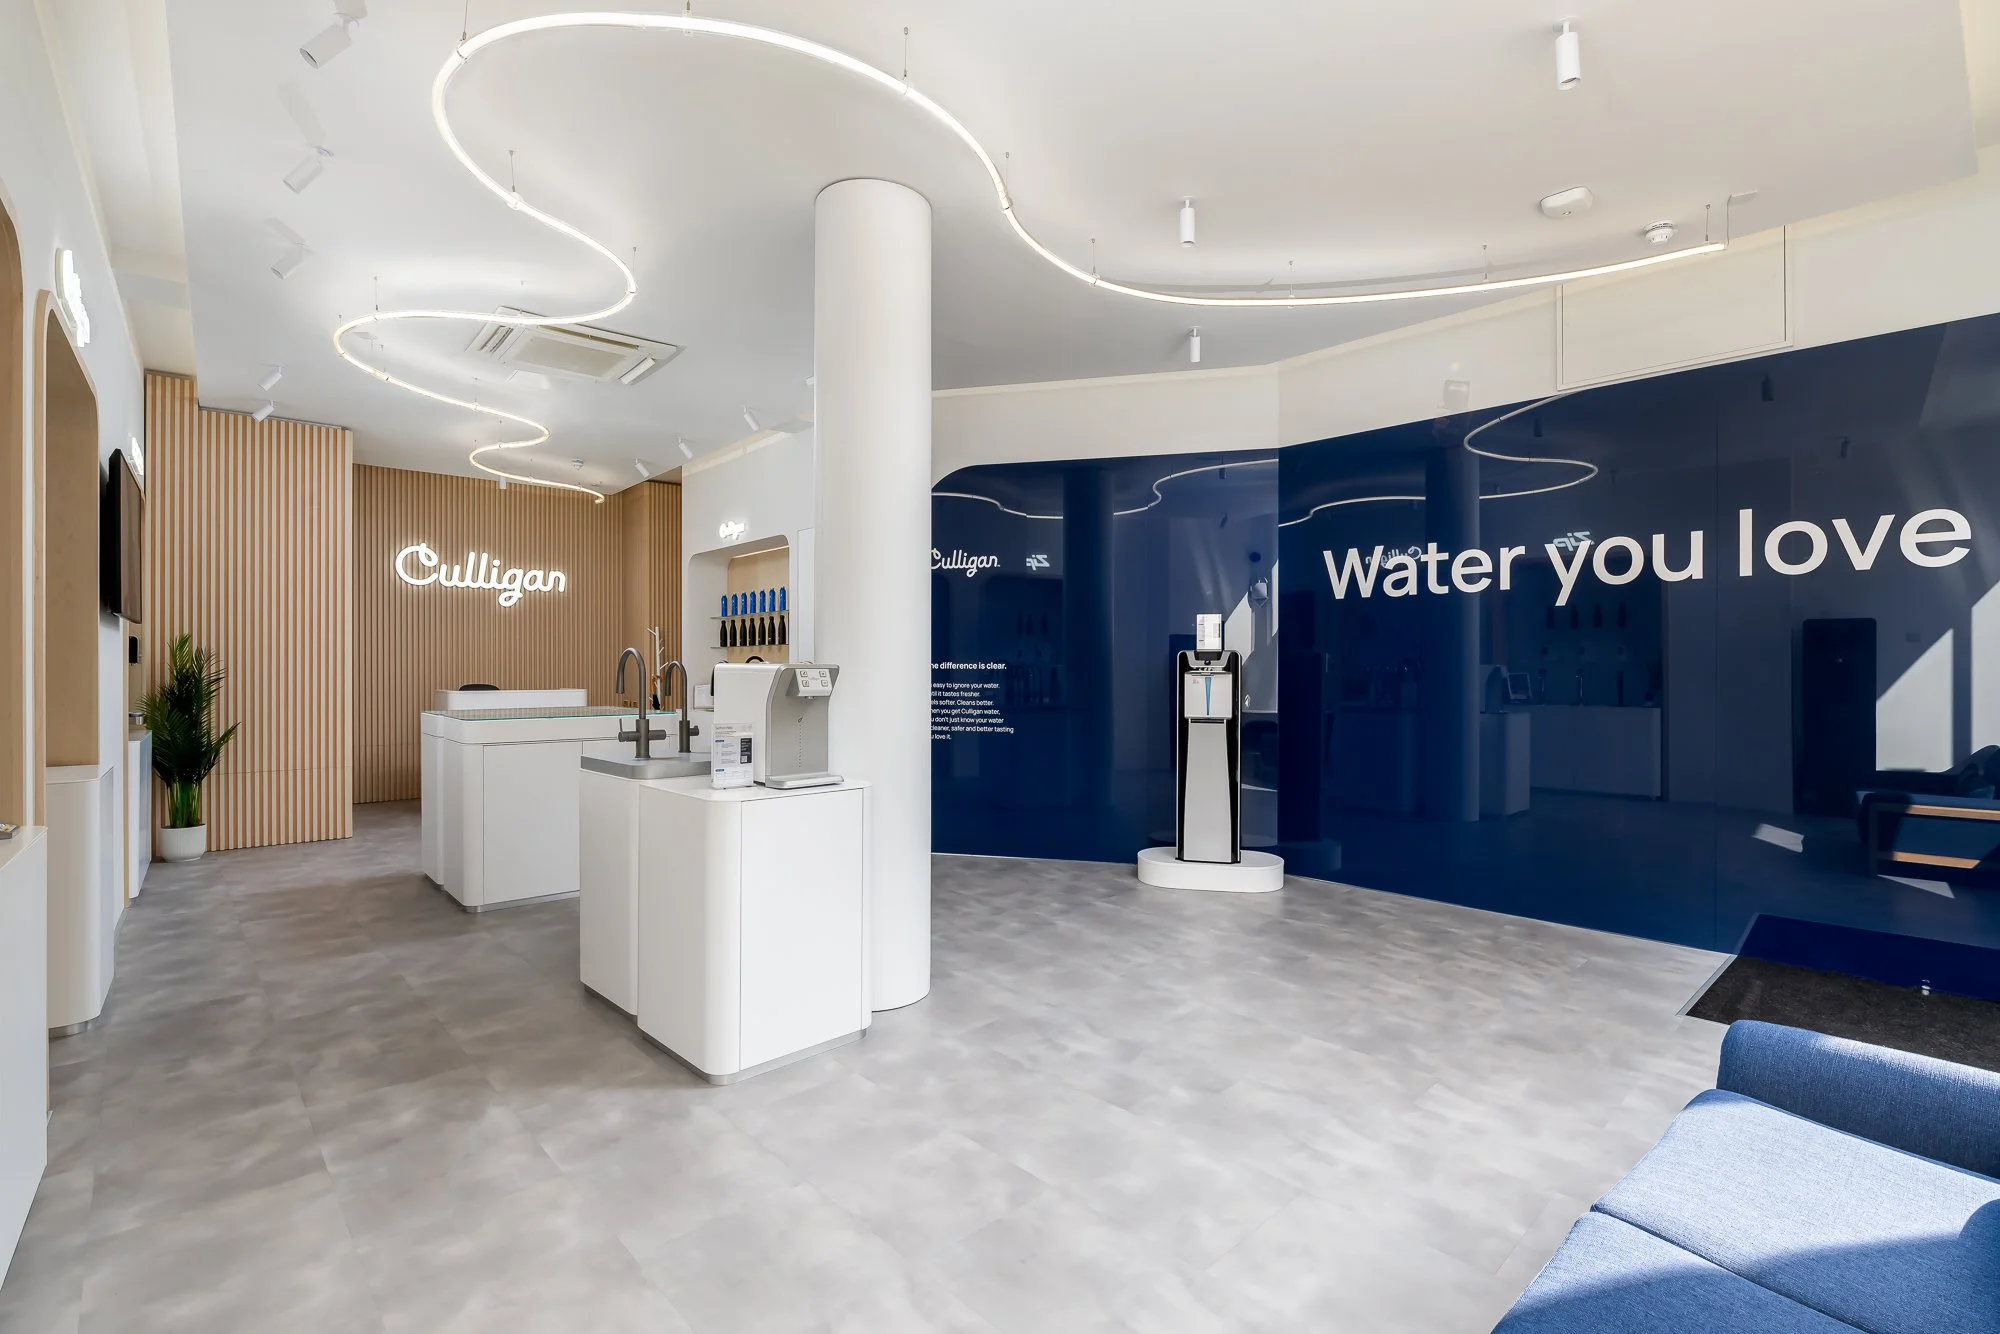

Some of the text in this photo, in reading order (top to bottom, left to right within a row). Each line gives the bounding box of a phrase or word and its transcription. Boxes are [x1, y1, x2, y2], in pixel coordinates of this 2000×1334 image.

[395, 542, 566, 608] Culligan
[1323, 507, 1973, 606] Water you love
[961, 708, 983, 716] Culligan
